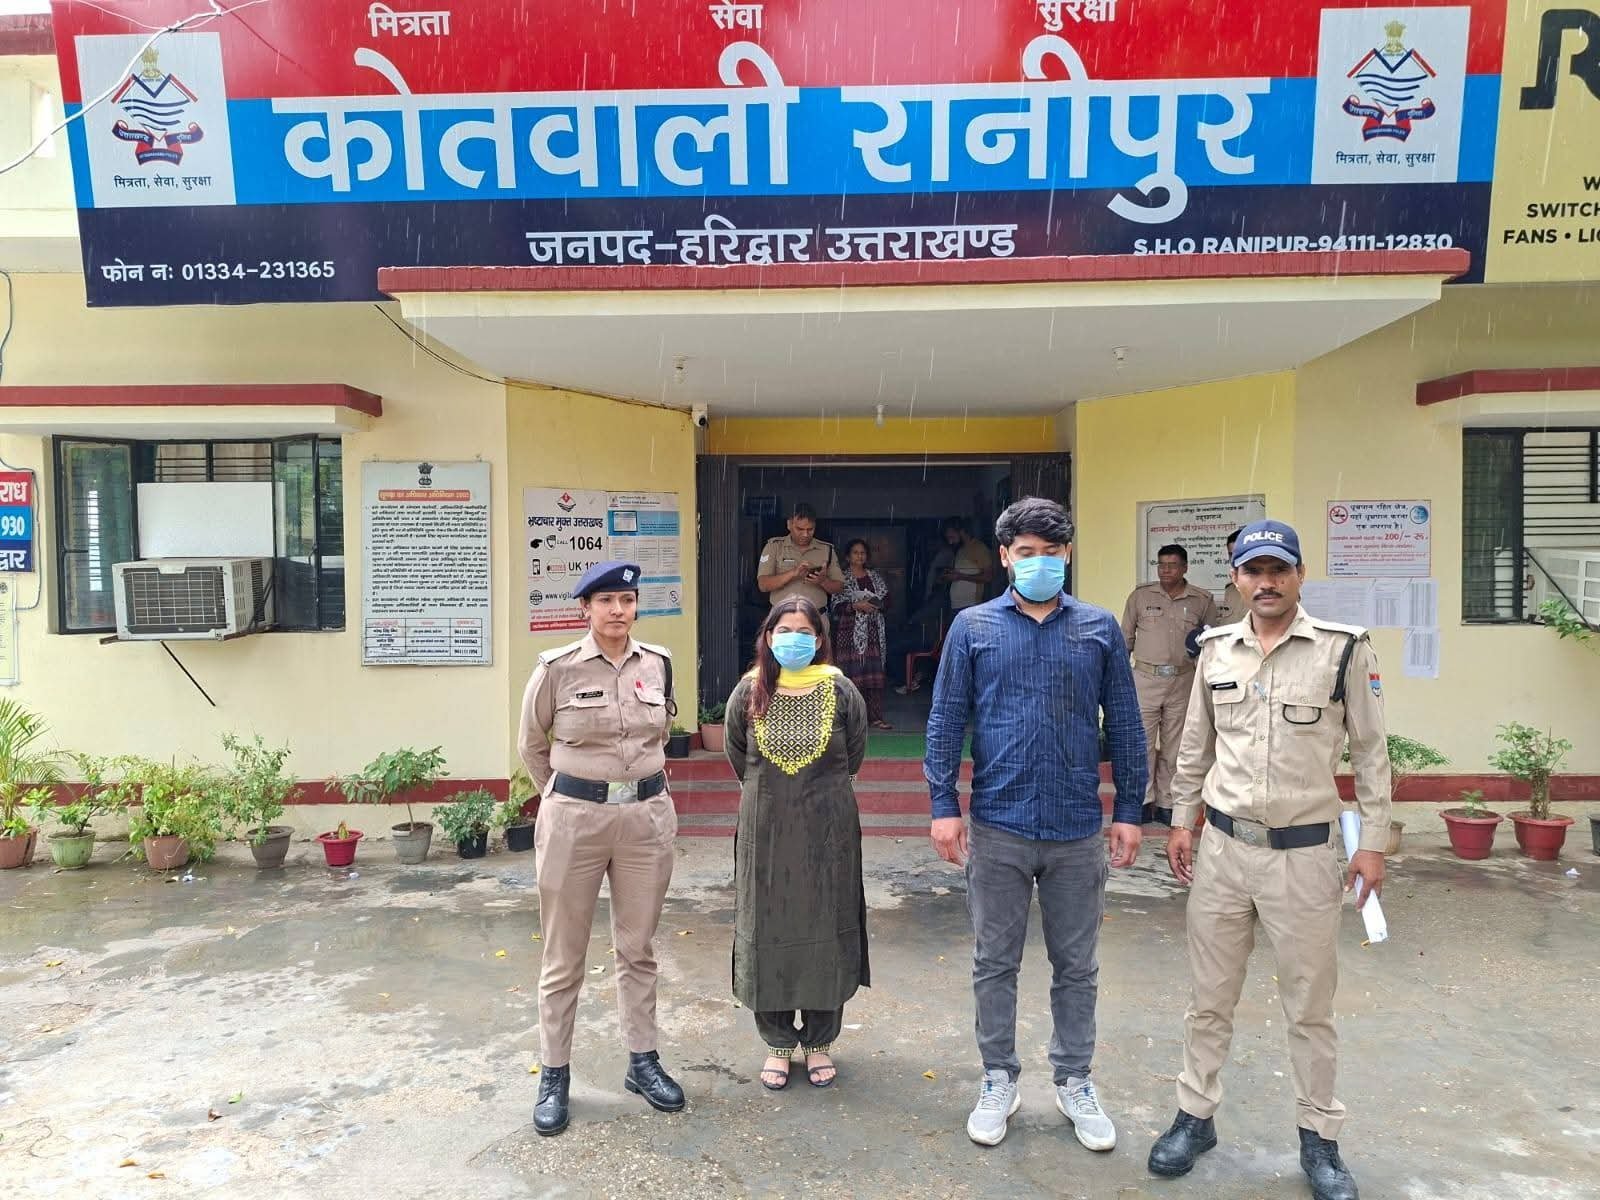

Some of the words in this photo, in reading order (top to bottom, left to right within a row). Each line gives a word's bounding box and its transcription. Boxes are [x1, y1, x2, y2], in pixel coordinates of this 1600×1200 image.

[368, 2, 451, 37] मित्रता
[709, 1, 762, 30] सेवा
[1037, 0, 1117, 32] सुरक्षा
[272, 41, 799, 192] कोतवाली
[841, 34, 1271, 224] रानीपुर
[1336, 151, 1371, 165] मित्रता,
[1376, 150, 1401, 165] सेवा,
[1405, 152, 1435, 167] सुरक्षा
[114, 175, 149, 188] मित्रता,
[154, 174, 178, 188] सेवा,
[182, 175, 211, 190] सुरक्षा
[526, 214, 811, 265] जनपद-हरिद्वार
[826, 223, 1018, 261] उत्तराखण्ड
[1503, 228, 1557, 244] FANS
[101, 257, 144, 282] फोन
[182, 260, 335, 281] 01334-231365
[573, 516, 604, 529] उत्तराखण्ड
[569, 536, 604, 551] 1064
[1243, 530, 1284, 545] POLICE
[568, 561, 582, 571] UK
